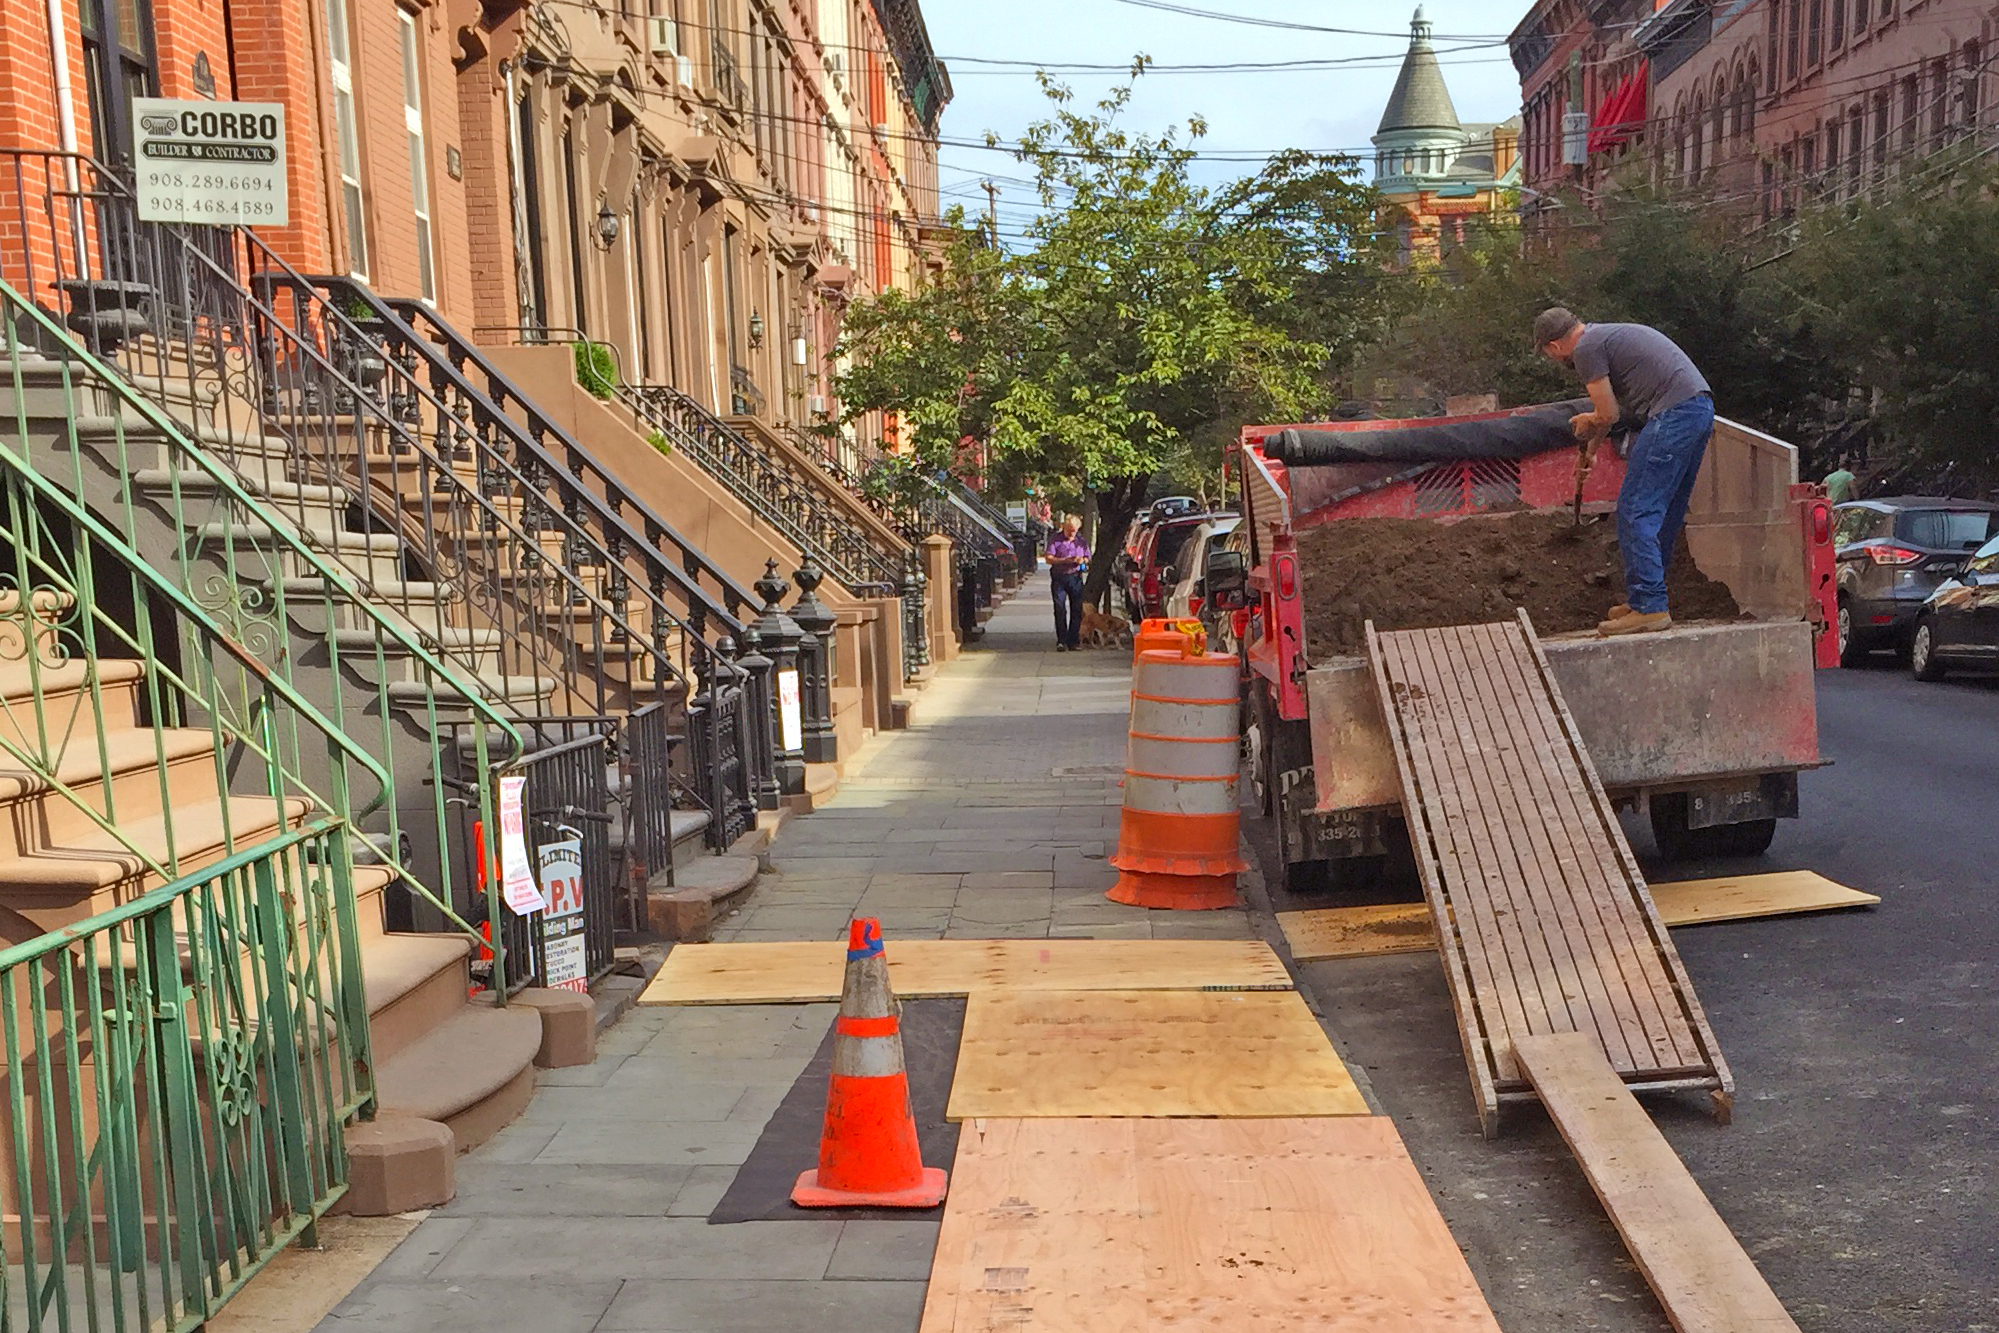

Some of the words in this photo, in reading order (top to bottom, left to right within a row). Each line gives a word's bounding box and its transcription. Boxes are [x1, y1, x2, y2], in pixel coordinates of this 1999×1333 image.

[181, 111, 277, 140] CORBO
[147, 144, 188, 157] BUILDER
[205, 146, 272, 160] CONTRACTOR
[150, 173, 272, 191] 908.289.6694
[151, 197, 273, 215] 908.468.4589
[540, 849, 581, 868] LIMITE
